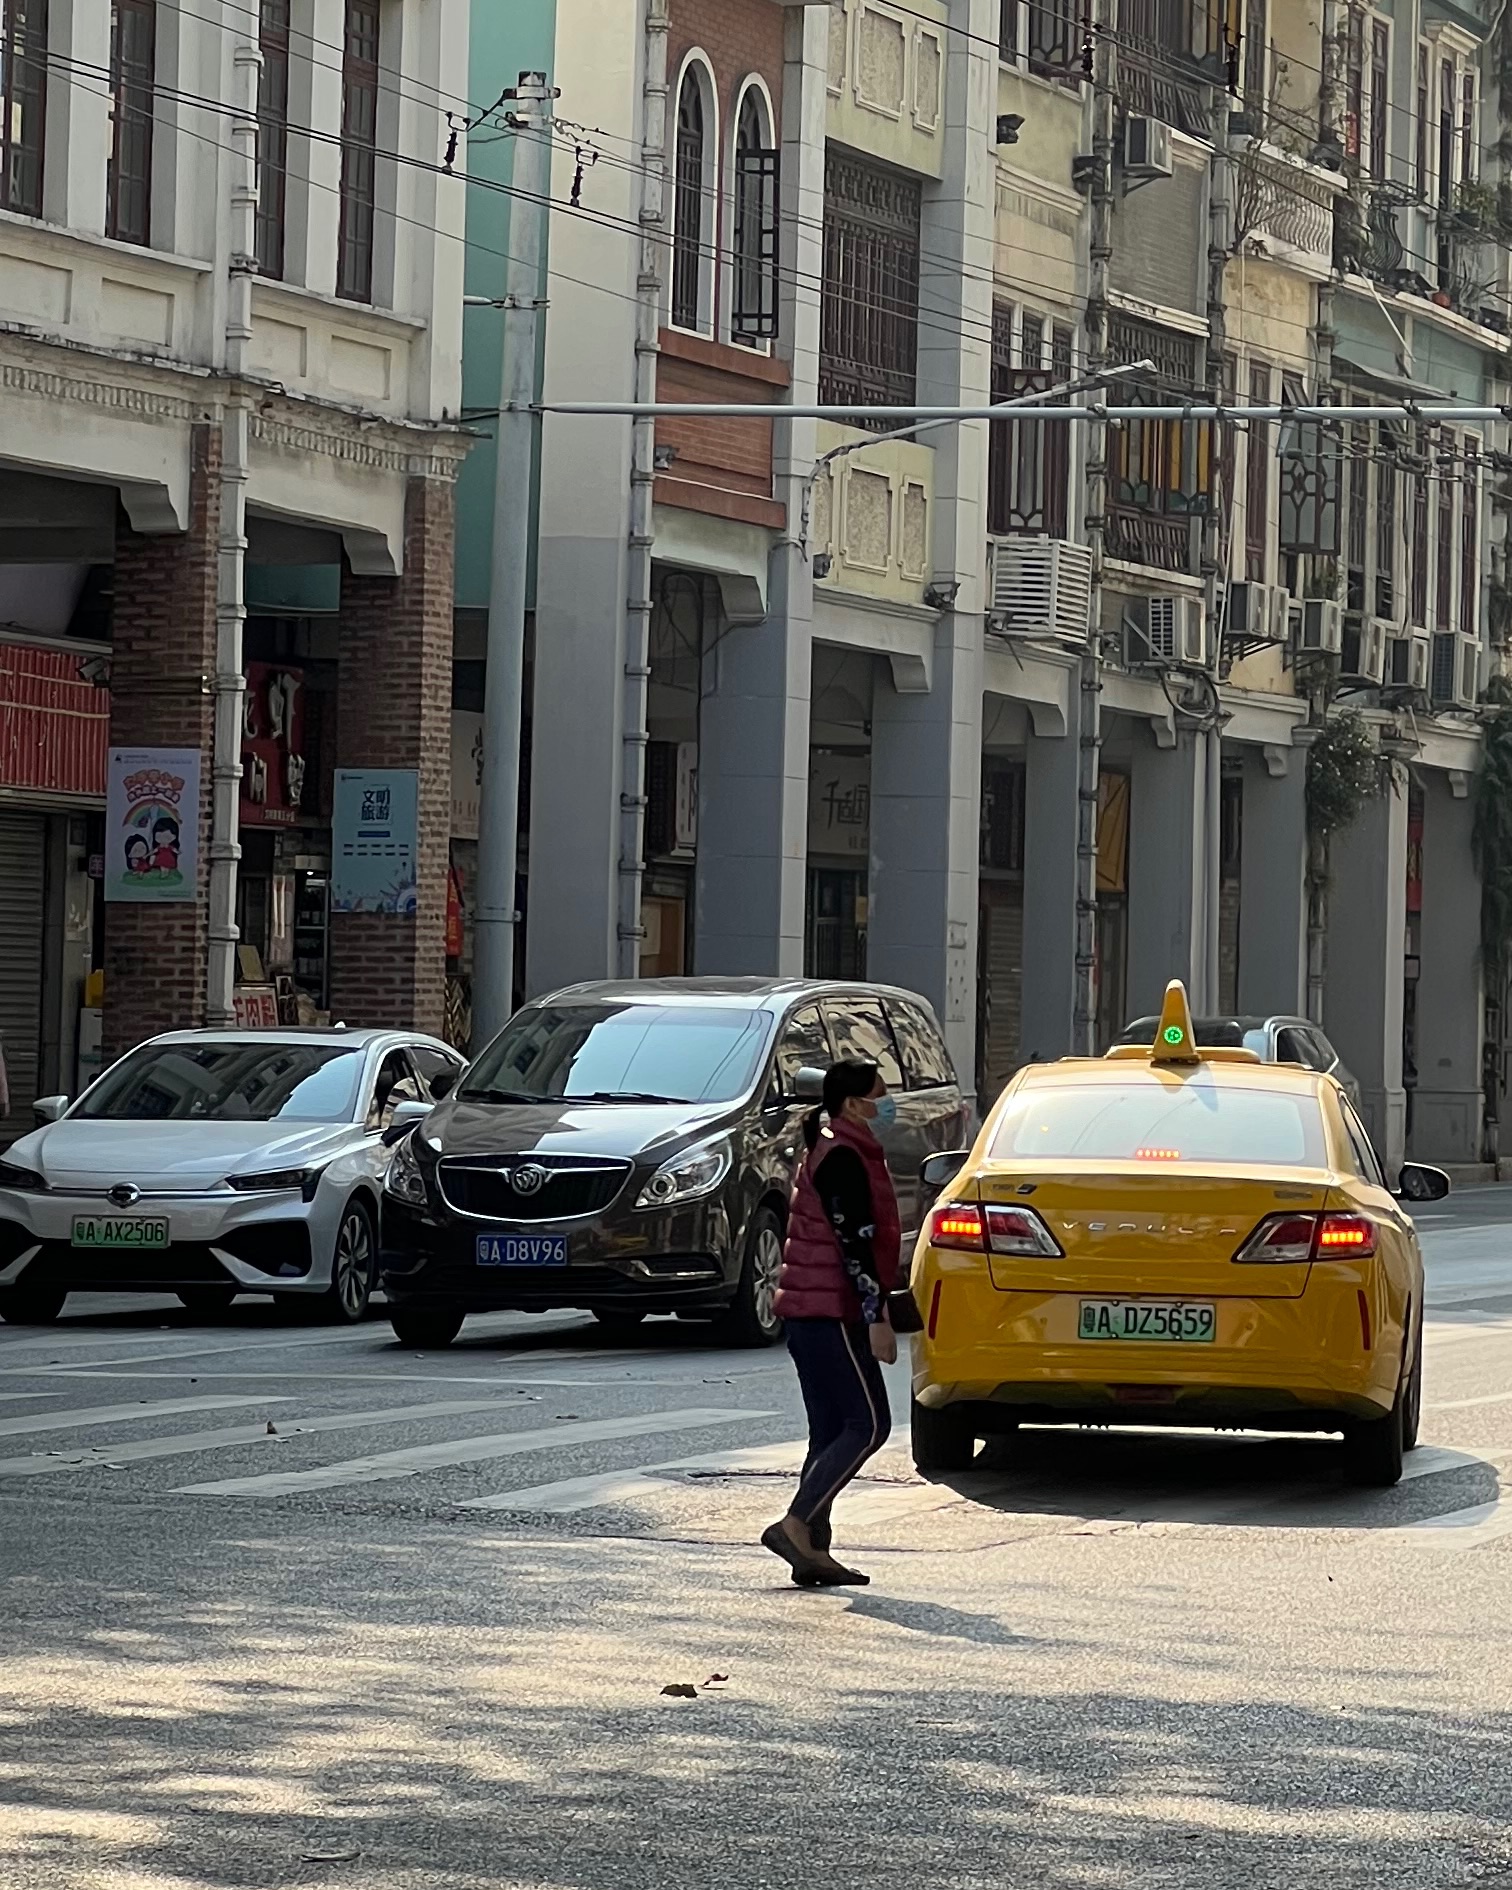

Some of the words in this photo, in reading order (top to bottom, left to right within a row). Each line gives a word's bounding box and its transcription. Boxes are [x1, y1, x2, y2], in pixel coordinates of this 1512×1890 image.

[363, 788, 390, 804] 文明
[103, 1222, 165, 1242] AX2506
[1123, 1306, 1213, 1337] DZ5659
